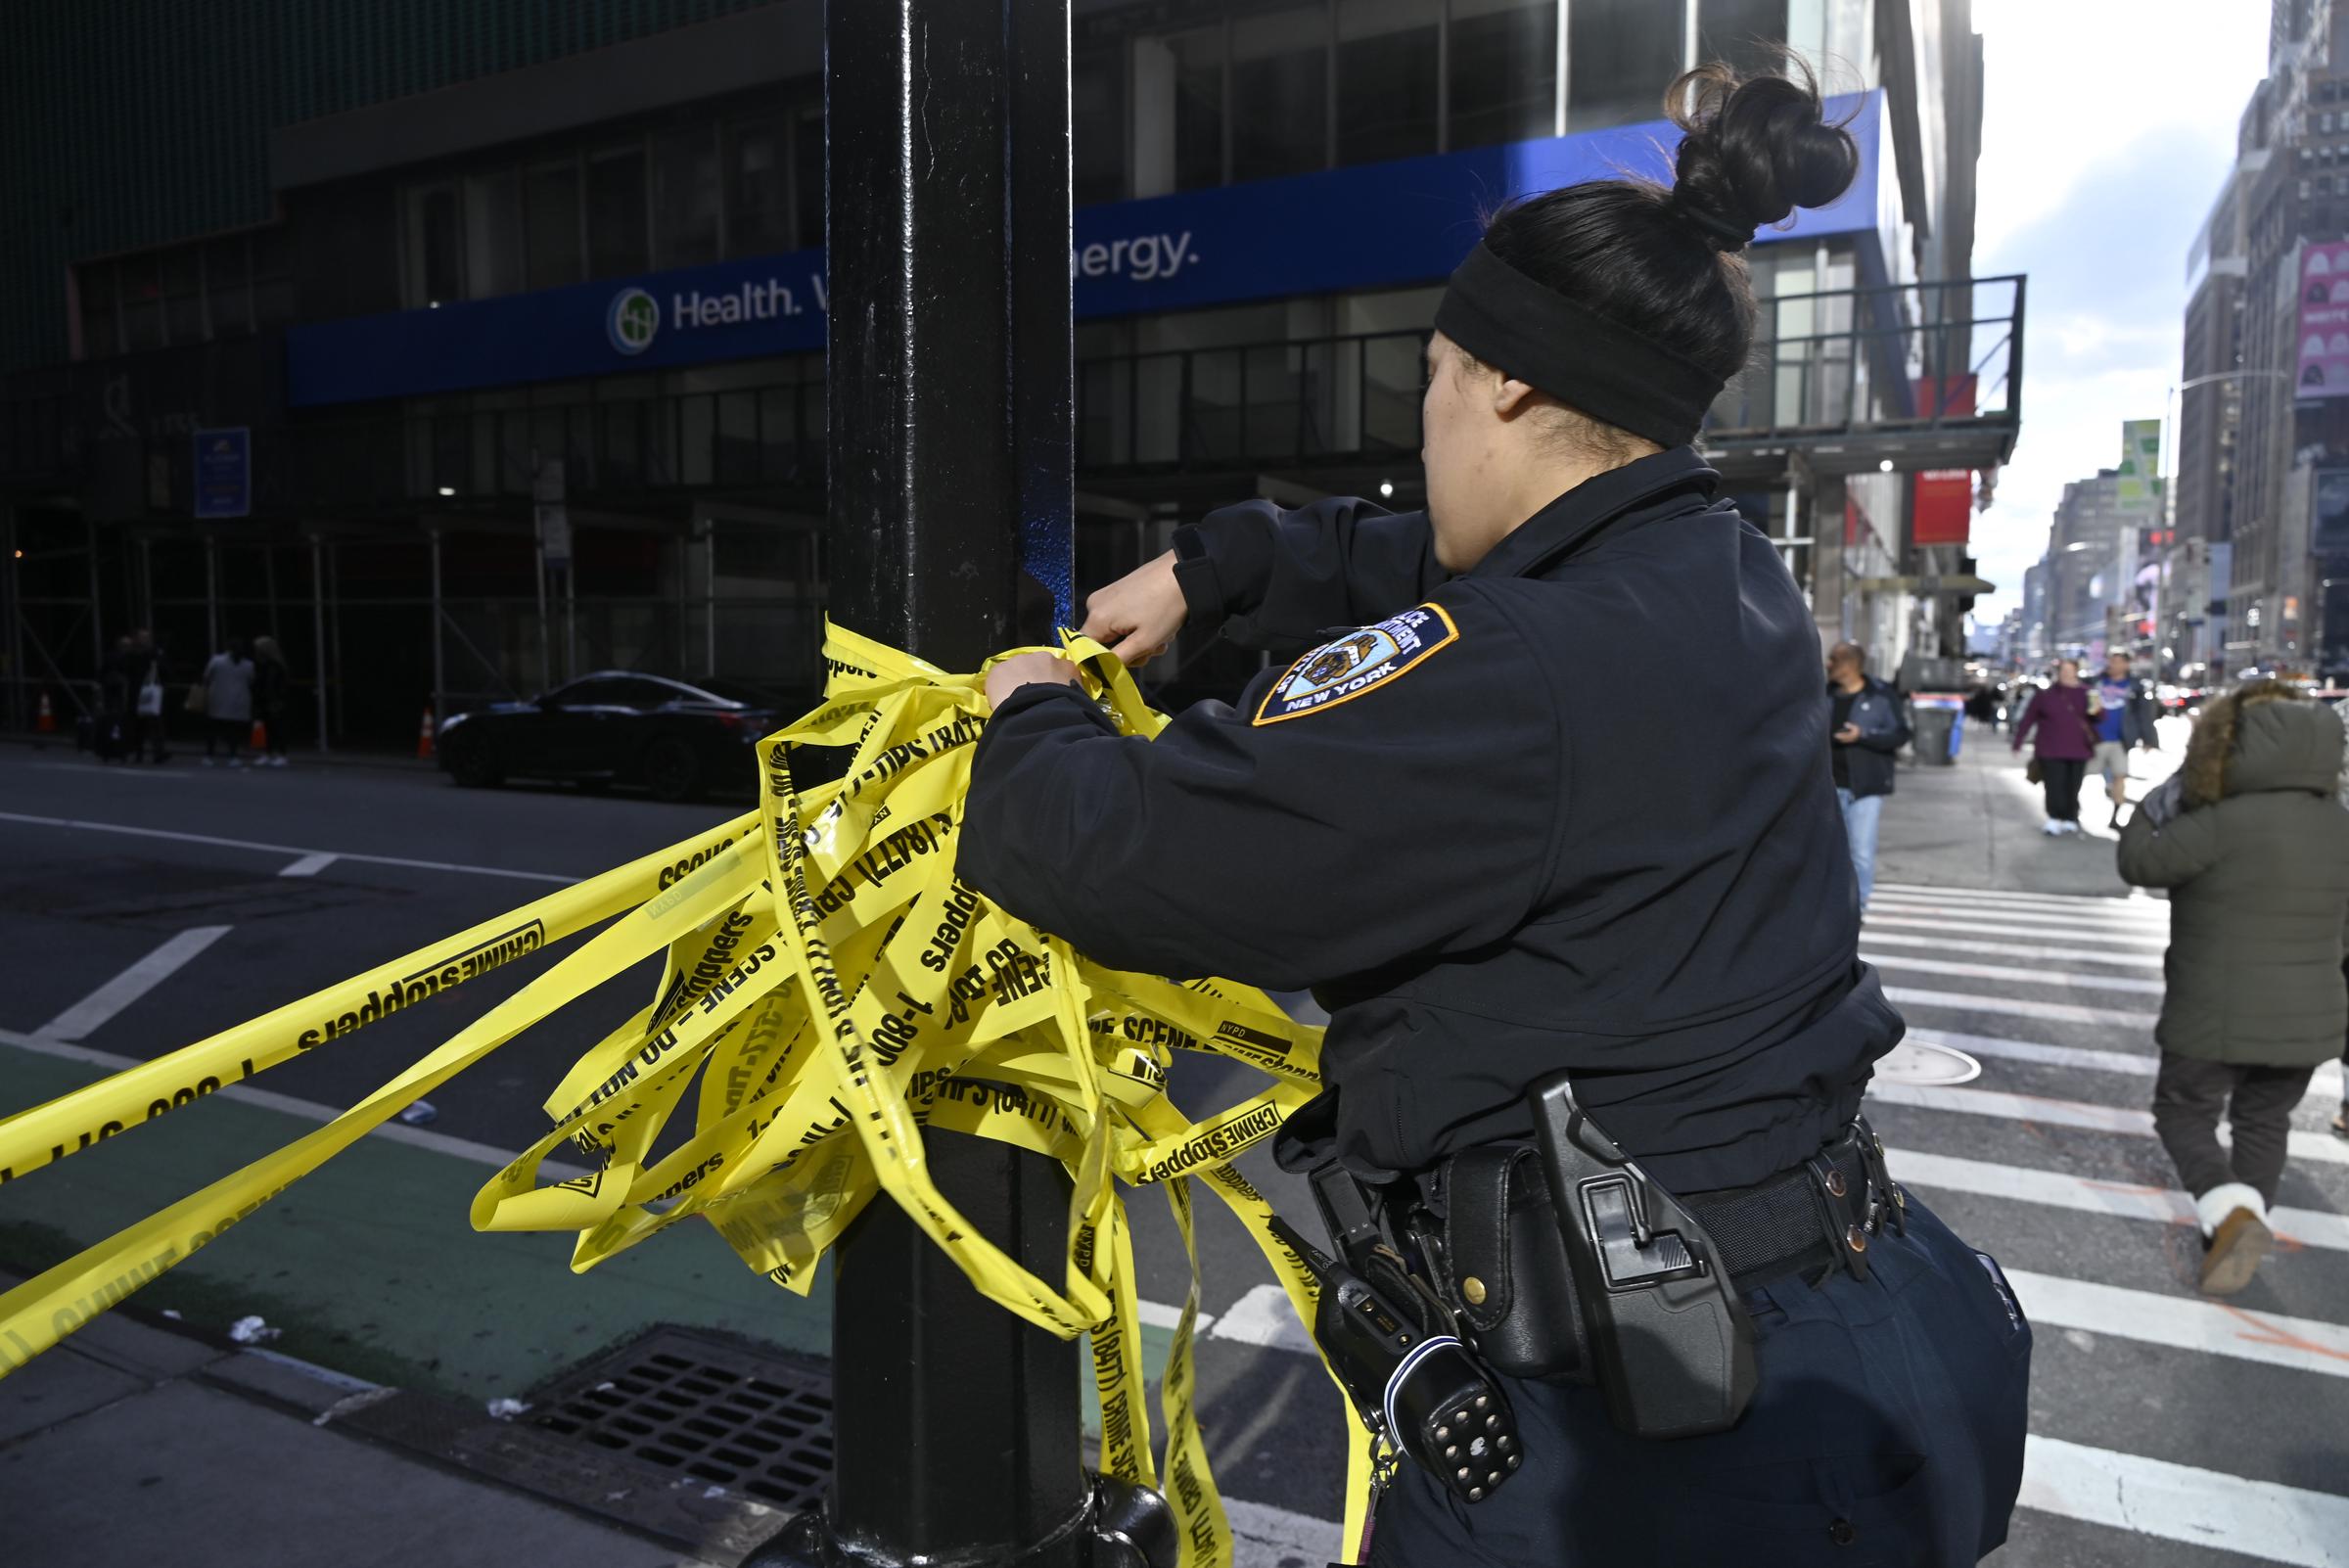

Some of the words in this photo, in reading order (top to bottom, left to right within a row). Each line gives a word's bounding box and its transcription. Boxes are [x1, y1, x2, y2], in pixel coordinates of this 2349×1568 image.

[673, 276, 804, 330] Health.
[1285, 690, 1331, 713] NEW
[1333, 662, 1398, 696] YORK
[1221, 1021, 1246, 1038] NYPD
[1091, 1328, 1123, 1392] (8477)
[1101, 1391, 1132, 1453] CRIME
